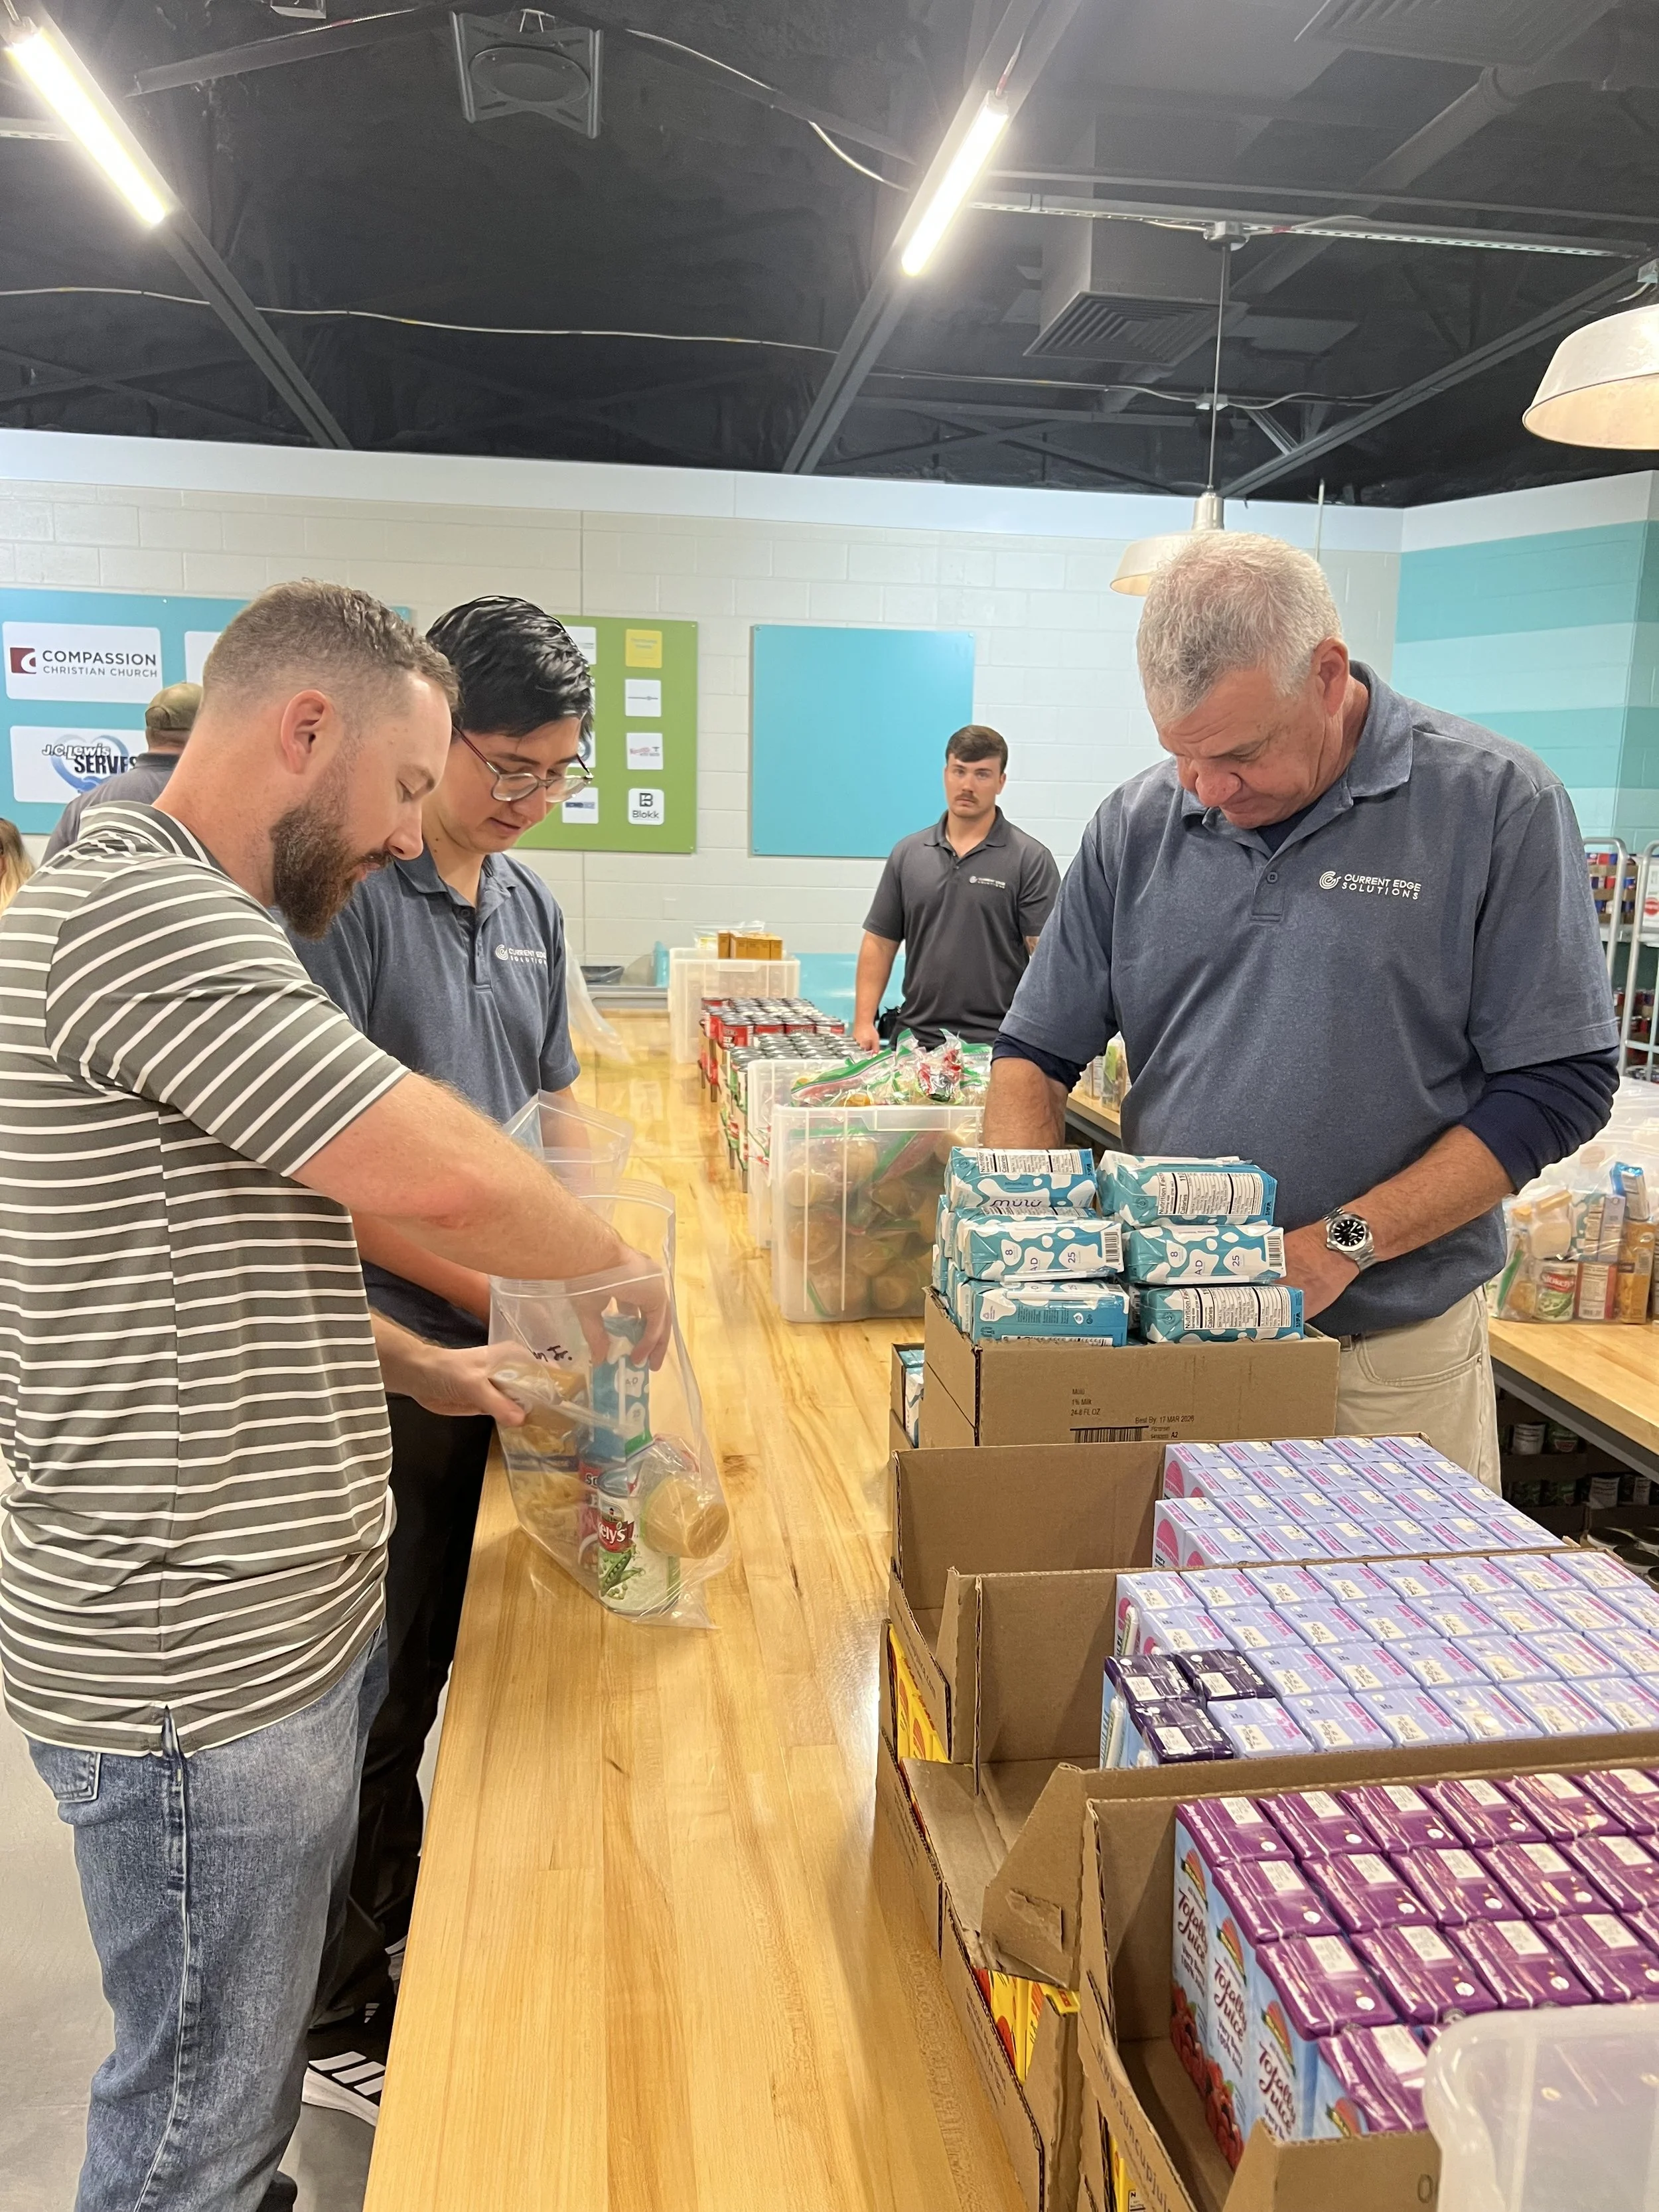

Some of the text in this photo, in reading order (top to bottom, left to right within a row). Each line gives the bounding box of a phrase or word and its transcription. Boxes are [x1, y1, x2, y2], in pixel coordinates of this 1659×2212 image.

[42, 650, 156, 666] COMPASSION
[43, 666, 157, 678] CHRISTIAN CHURCH
[632, 810, 660, 820] Blokk
[1342, 882, 1419, 900] SOLUTIONS
[1392, 879, 1421, 892] EDGE
[1068, 1252, 1076, 1263] 25
[1232, 1255, 1240, 1266] 25
[547, 1345, 573, 1361] Jr.
[1179, 1888, 1208, 1954] Totally
[1178, 1920, 1205, 1964] Juice
[1215, 1958, 1247, 2032] Totally
[1214, 1993, 1243, 2042] Juice
[1260, 2041, 1296, 2124] Totally
[1260, 2079, 1291, 2136] Juice
[1097, 2037, 1172, 2212] www.suncupjui
